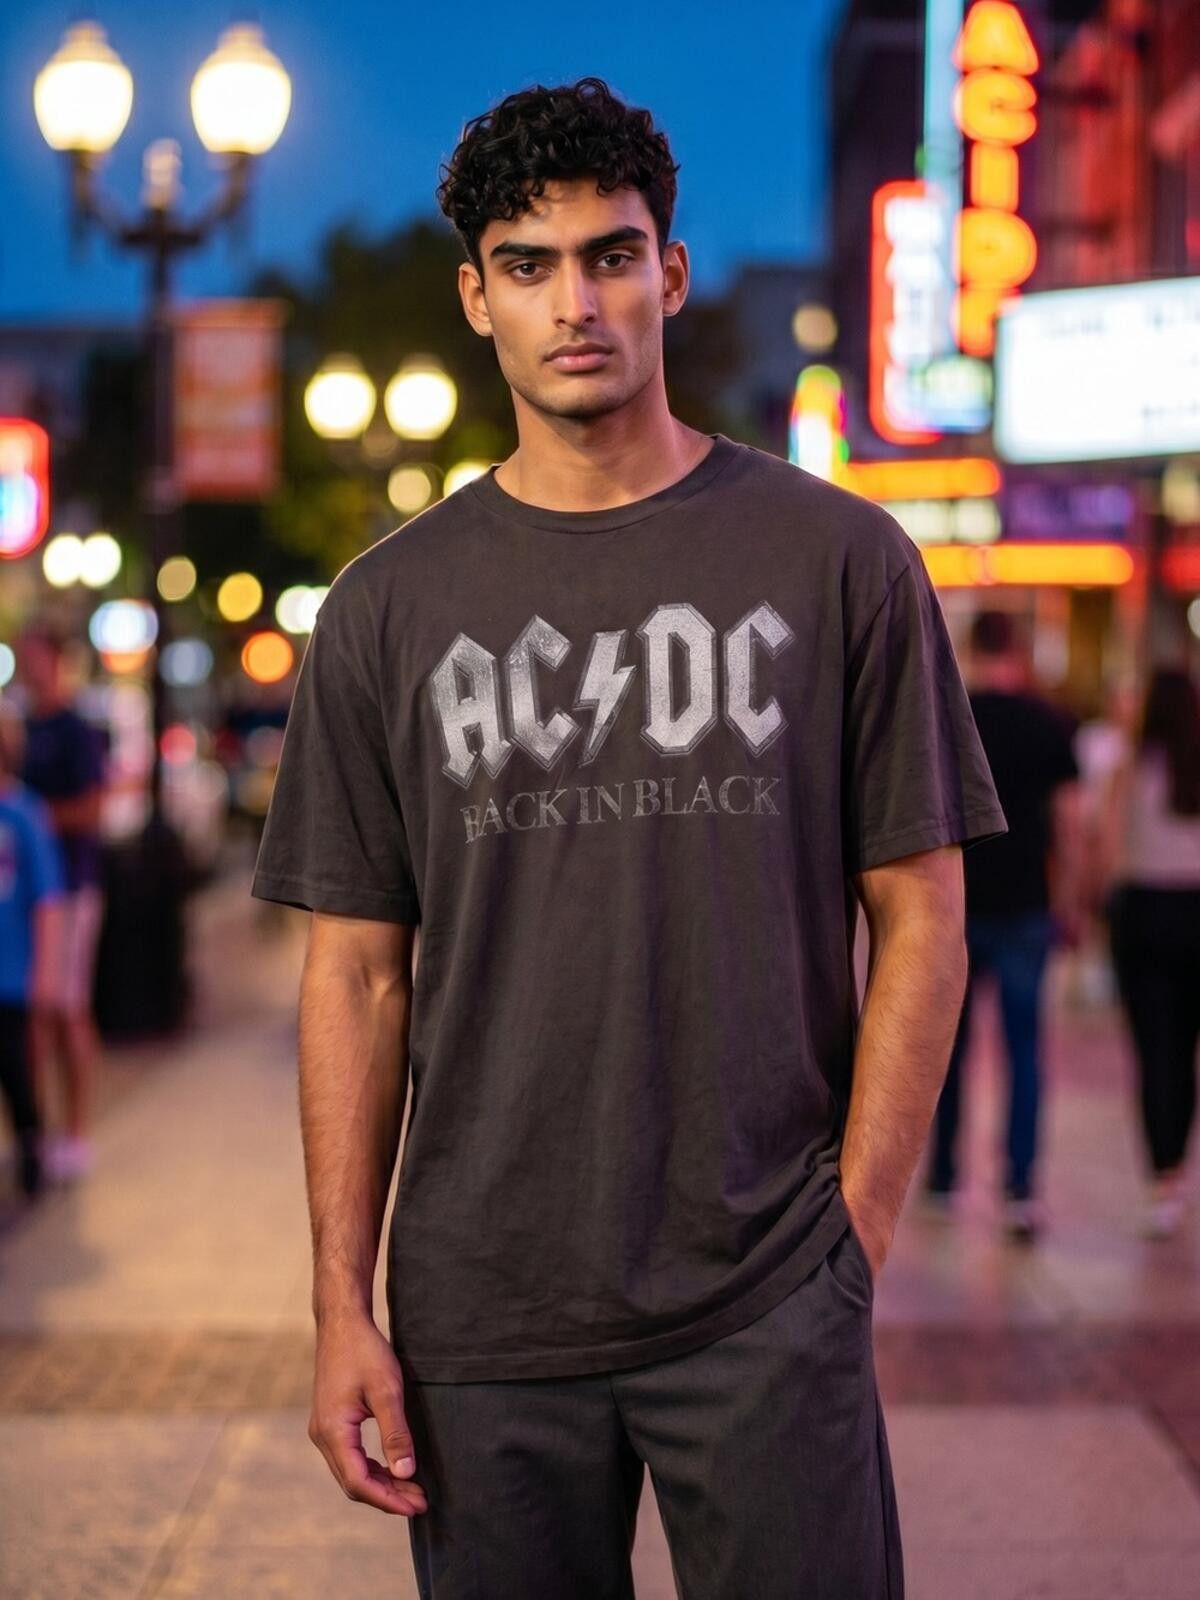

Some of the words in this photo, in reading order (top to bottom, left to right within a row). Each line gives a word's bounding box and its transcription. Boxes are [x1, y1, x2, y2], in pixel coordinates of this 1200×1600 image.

[460, 788, 569, 844] BACK
[575, 782, 625, 825] IN
[632, 775, 782, 817] BLACK
